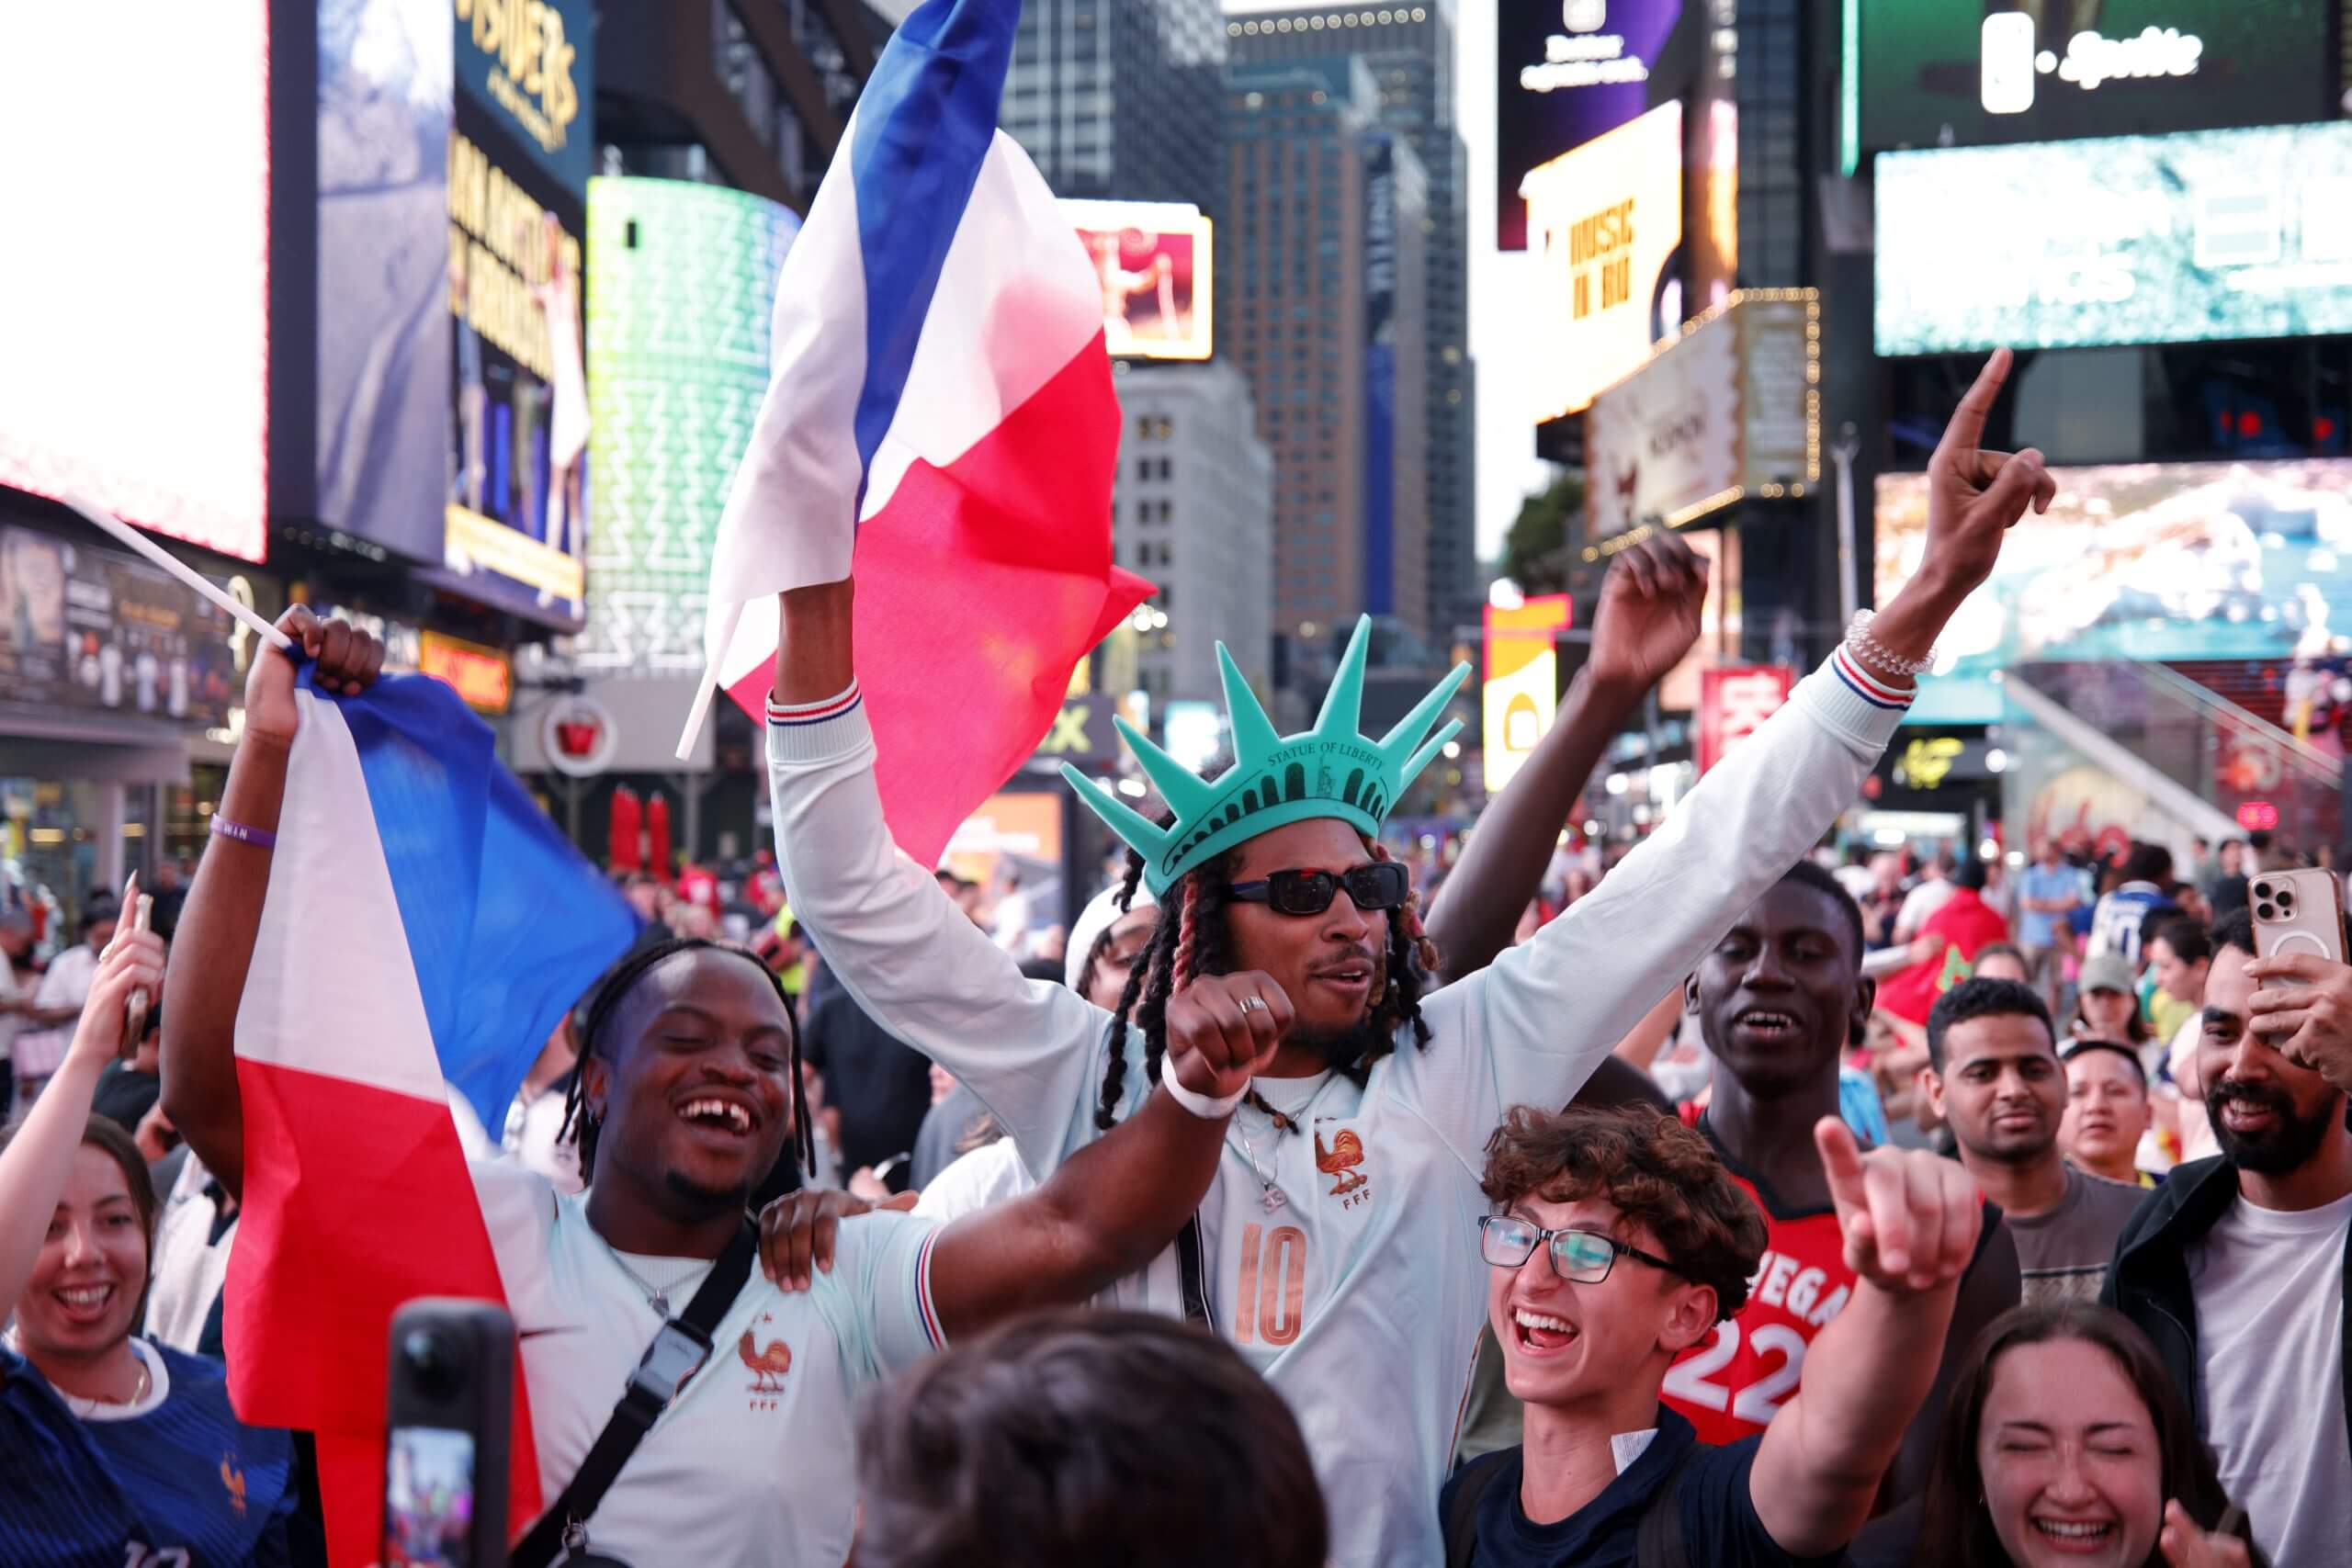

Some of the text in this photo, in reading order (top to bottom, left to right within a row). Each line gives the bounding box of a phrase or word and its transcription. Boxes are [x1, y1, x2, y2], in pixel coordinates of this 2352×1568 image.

[1268, 741, 1384, 771] STATUE OF LIBERTY
[223, 822, 248, 840] WIN
[1342, 1188, 1371, 1211] FFF
[1234, 1223, 1307, 1347] 10
[1661, 1317, 1810, 1426] 22
